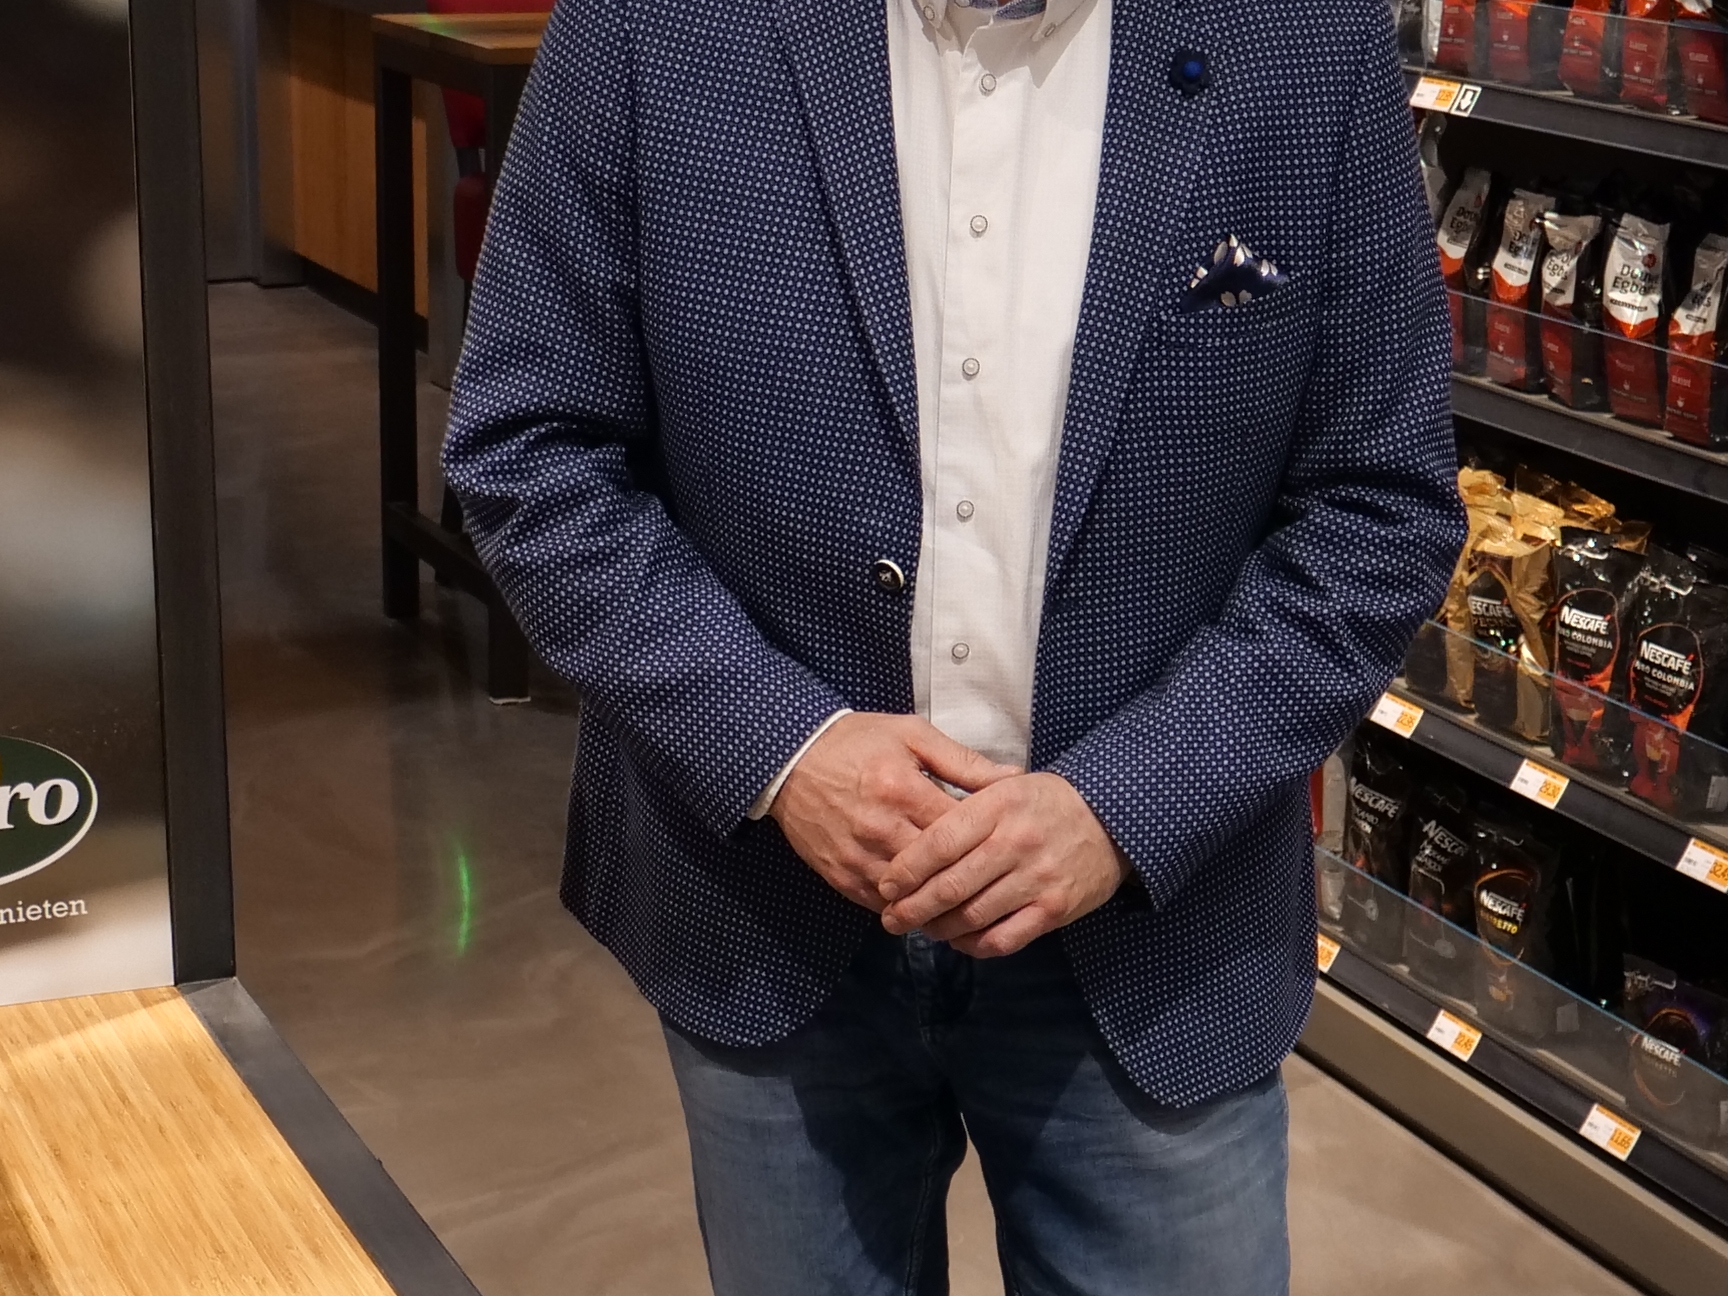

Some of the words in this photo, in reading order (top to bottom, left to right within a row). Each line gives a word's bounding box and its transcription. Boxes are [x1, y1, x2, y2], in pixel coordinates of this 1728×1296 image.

[1471, 600, 1513, 618] ESCAFÉ
[1572, 633, 1613, 650] COLOMBIA
[1651, 668, 1695, 691] COLOMBIA
